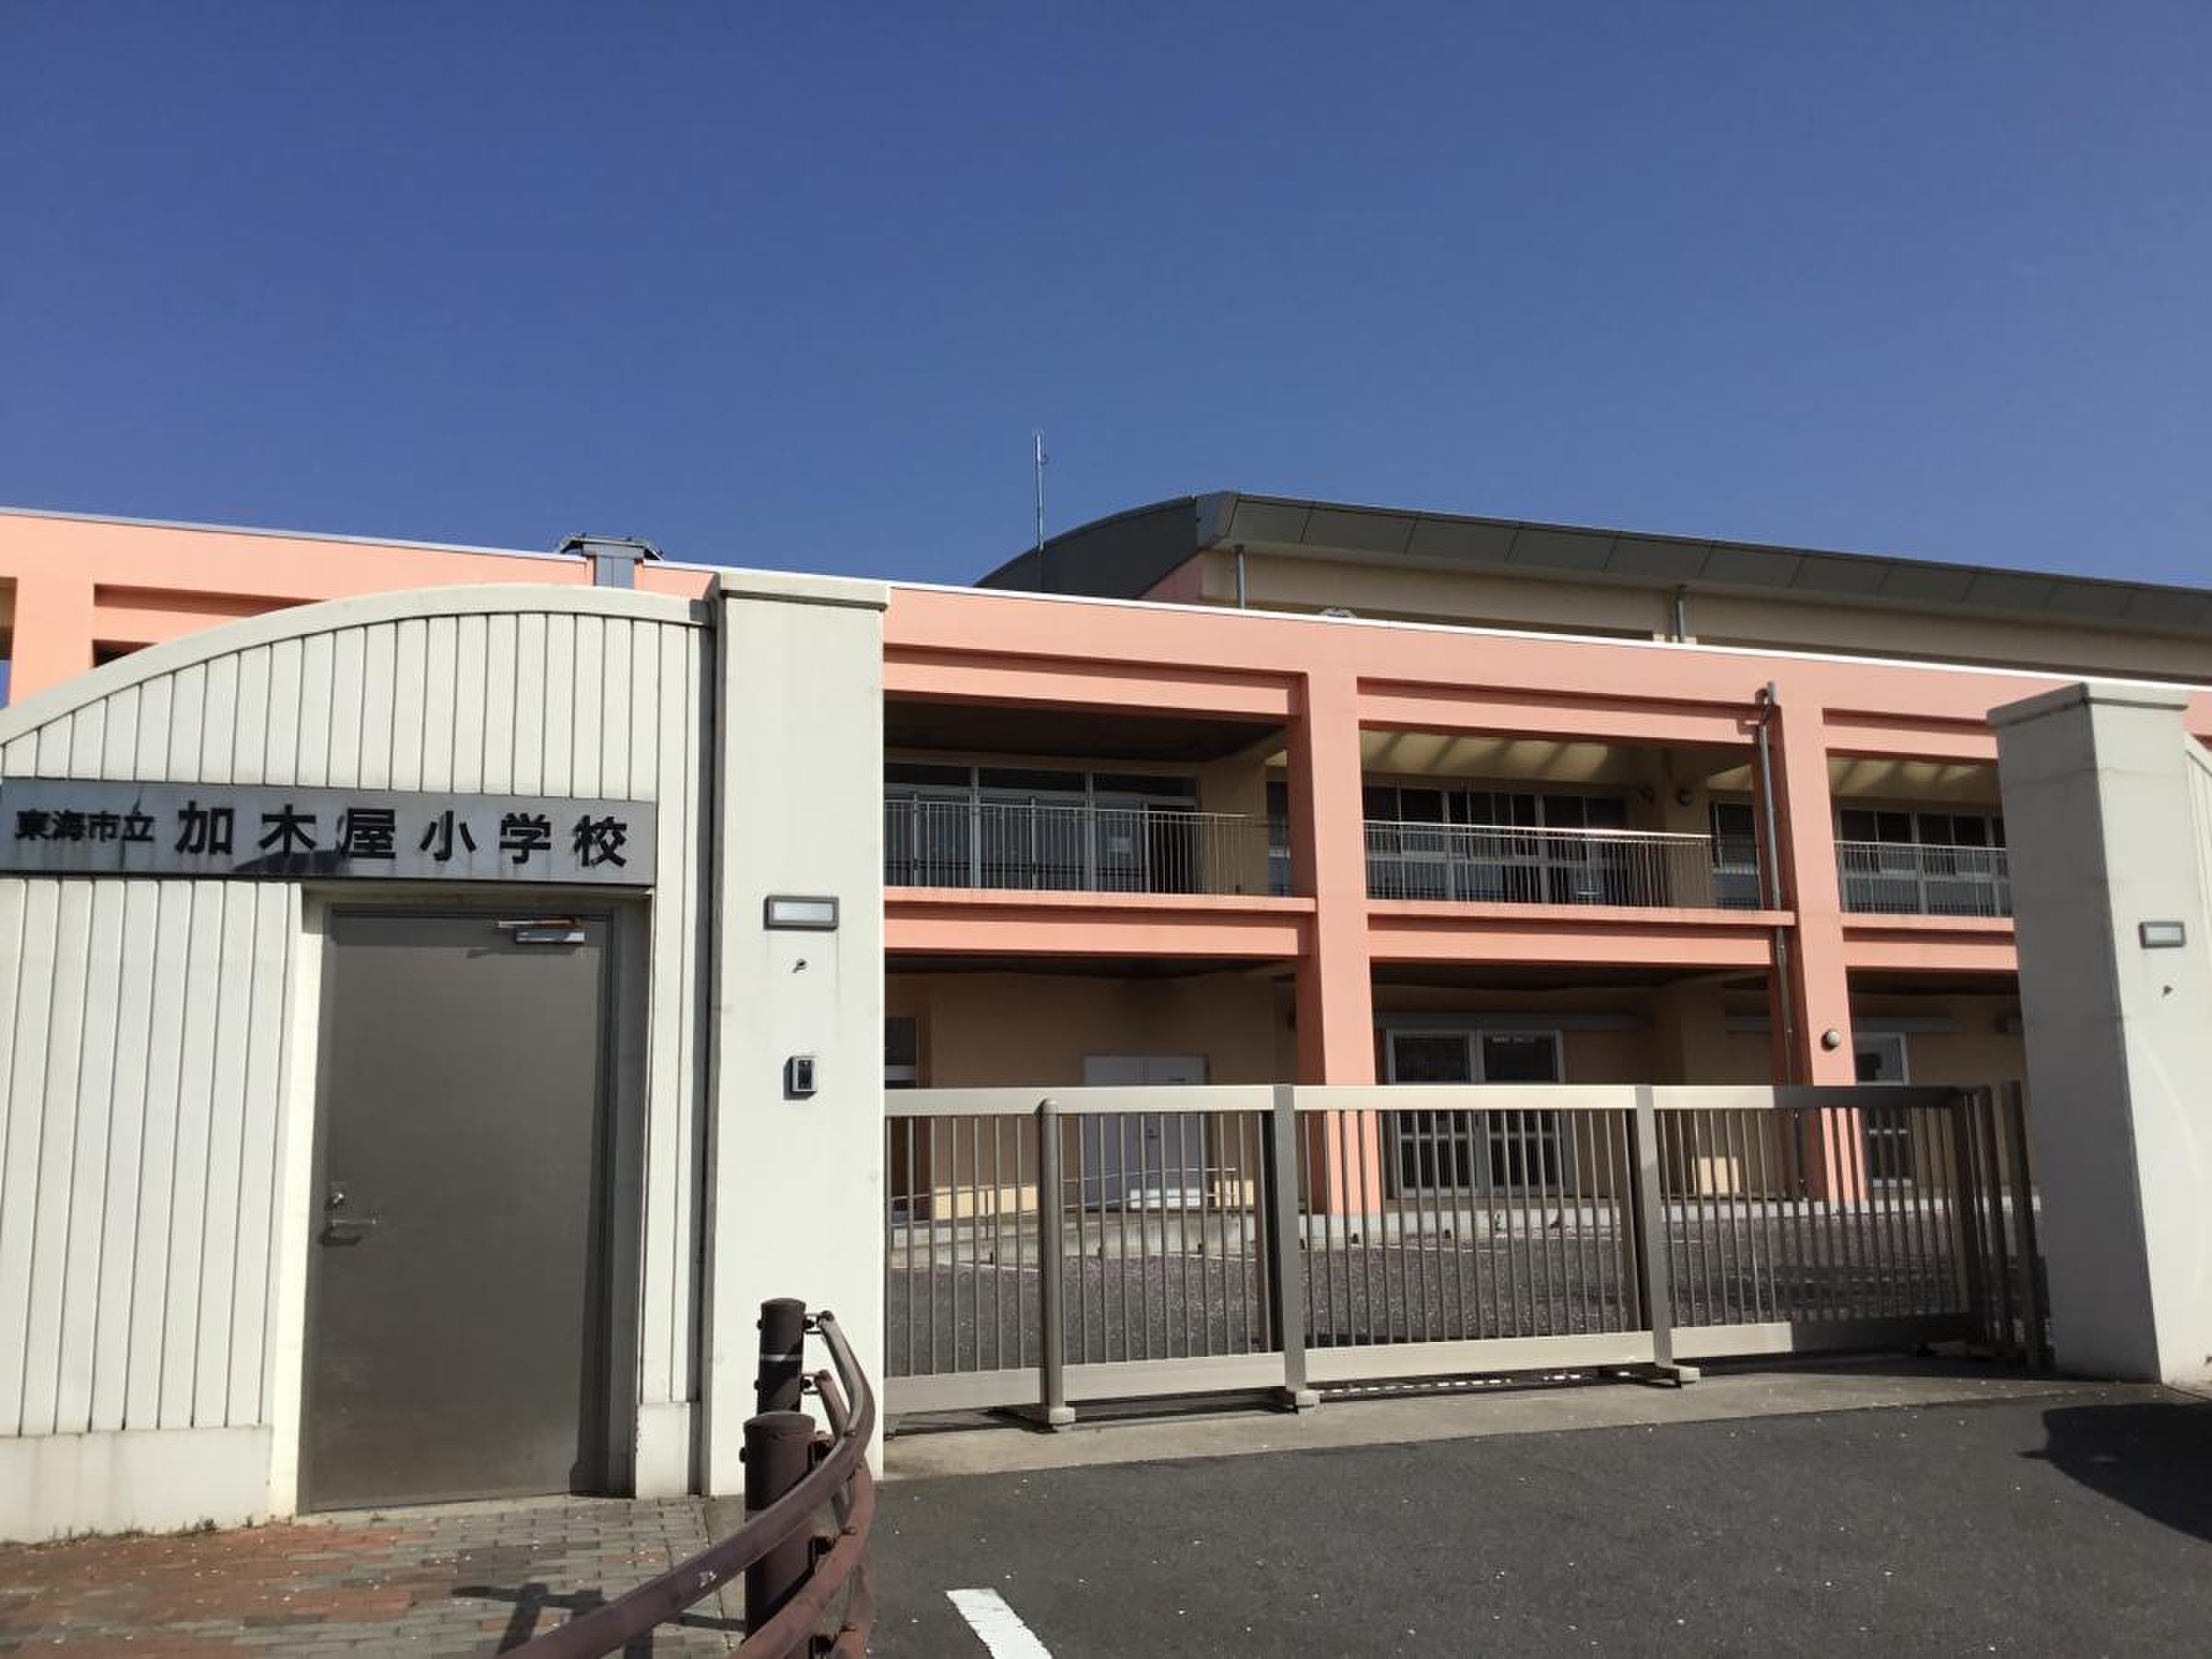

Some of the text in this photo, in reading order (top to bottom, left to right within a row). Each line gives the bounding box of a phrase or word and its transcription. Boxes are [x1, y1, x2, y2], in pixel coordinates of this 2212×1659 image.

[15, 801, 629, 867] 東海市立 加木屋小学校
